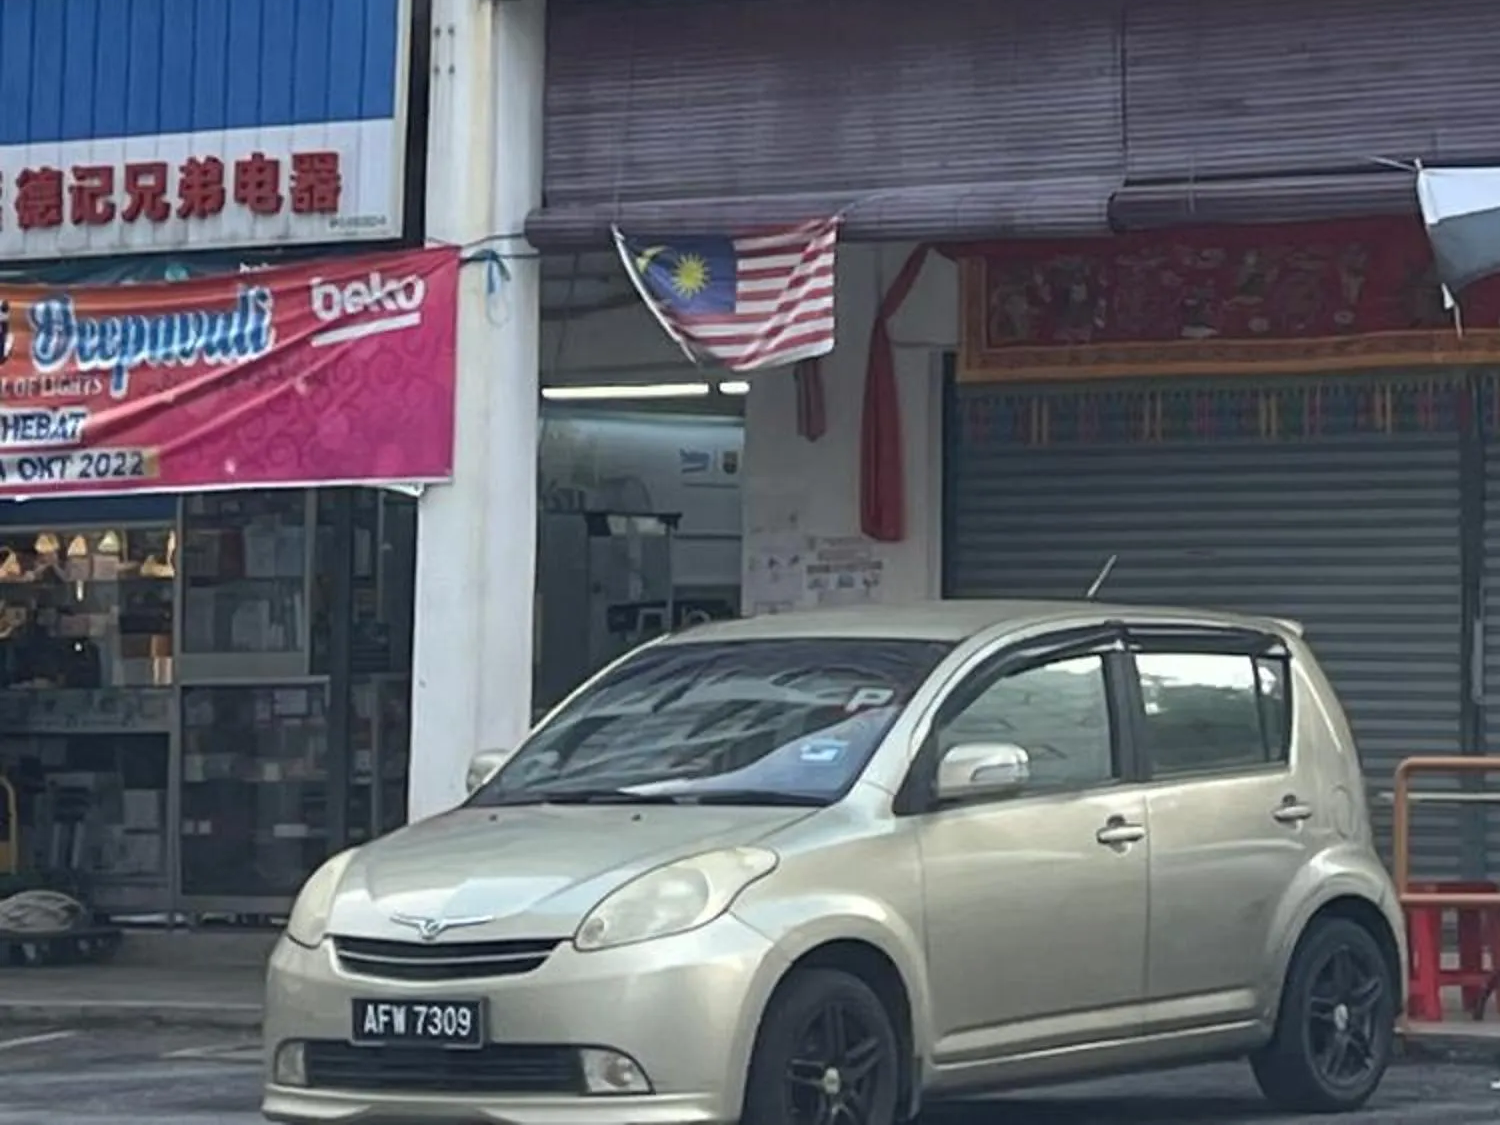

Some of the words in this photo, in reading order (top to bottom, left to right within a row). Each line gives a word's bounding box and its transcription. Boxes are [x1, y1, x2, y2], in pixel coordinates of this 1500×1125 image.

[0, 151, 342, 231] 德记兄弟电器
[311, 272, 424, 322] beko
[2, 412, 87, 442] HEBAT
[17, 453, 73, 481] OKT
[78, 450, 145, 479] 2022
[363, 1003, 407, 1035] AFW
[412, 1005, 472, 1036] 7309
